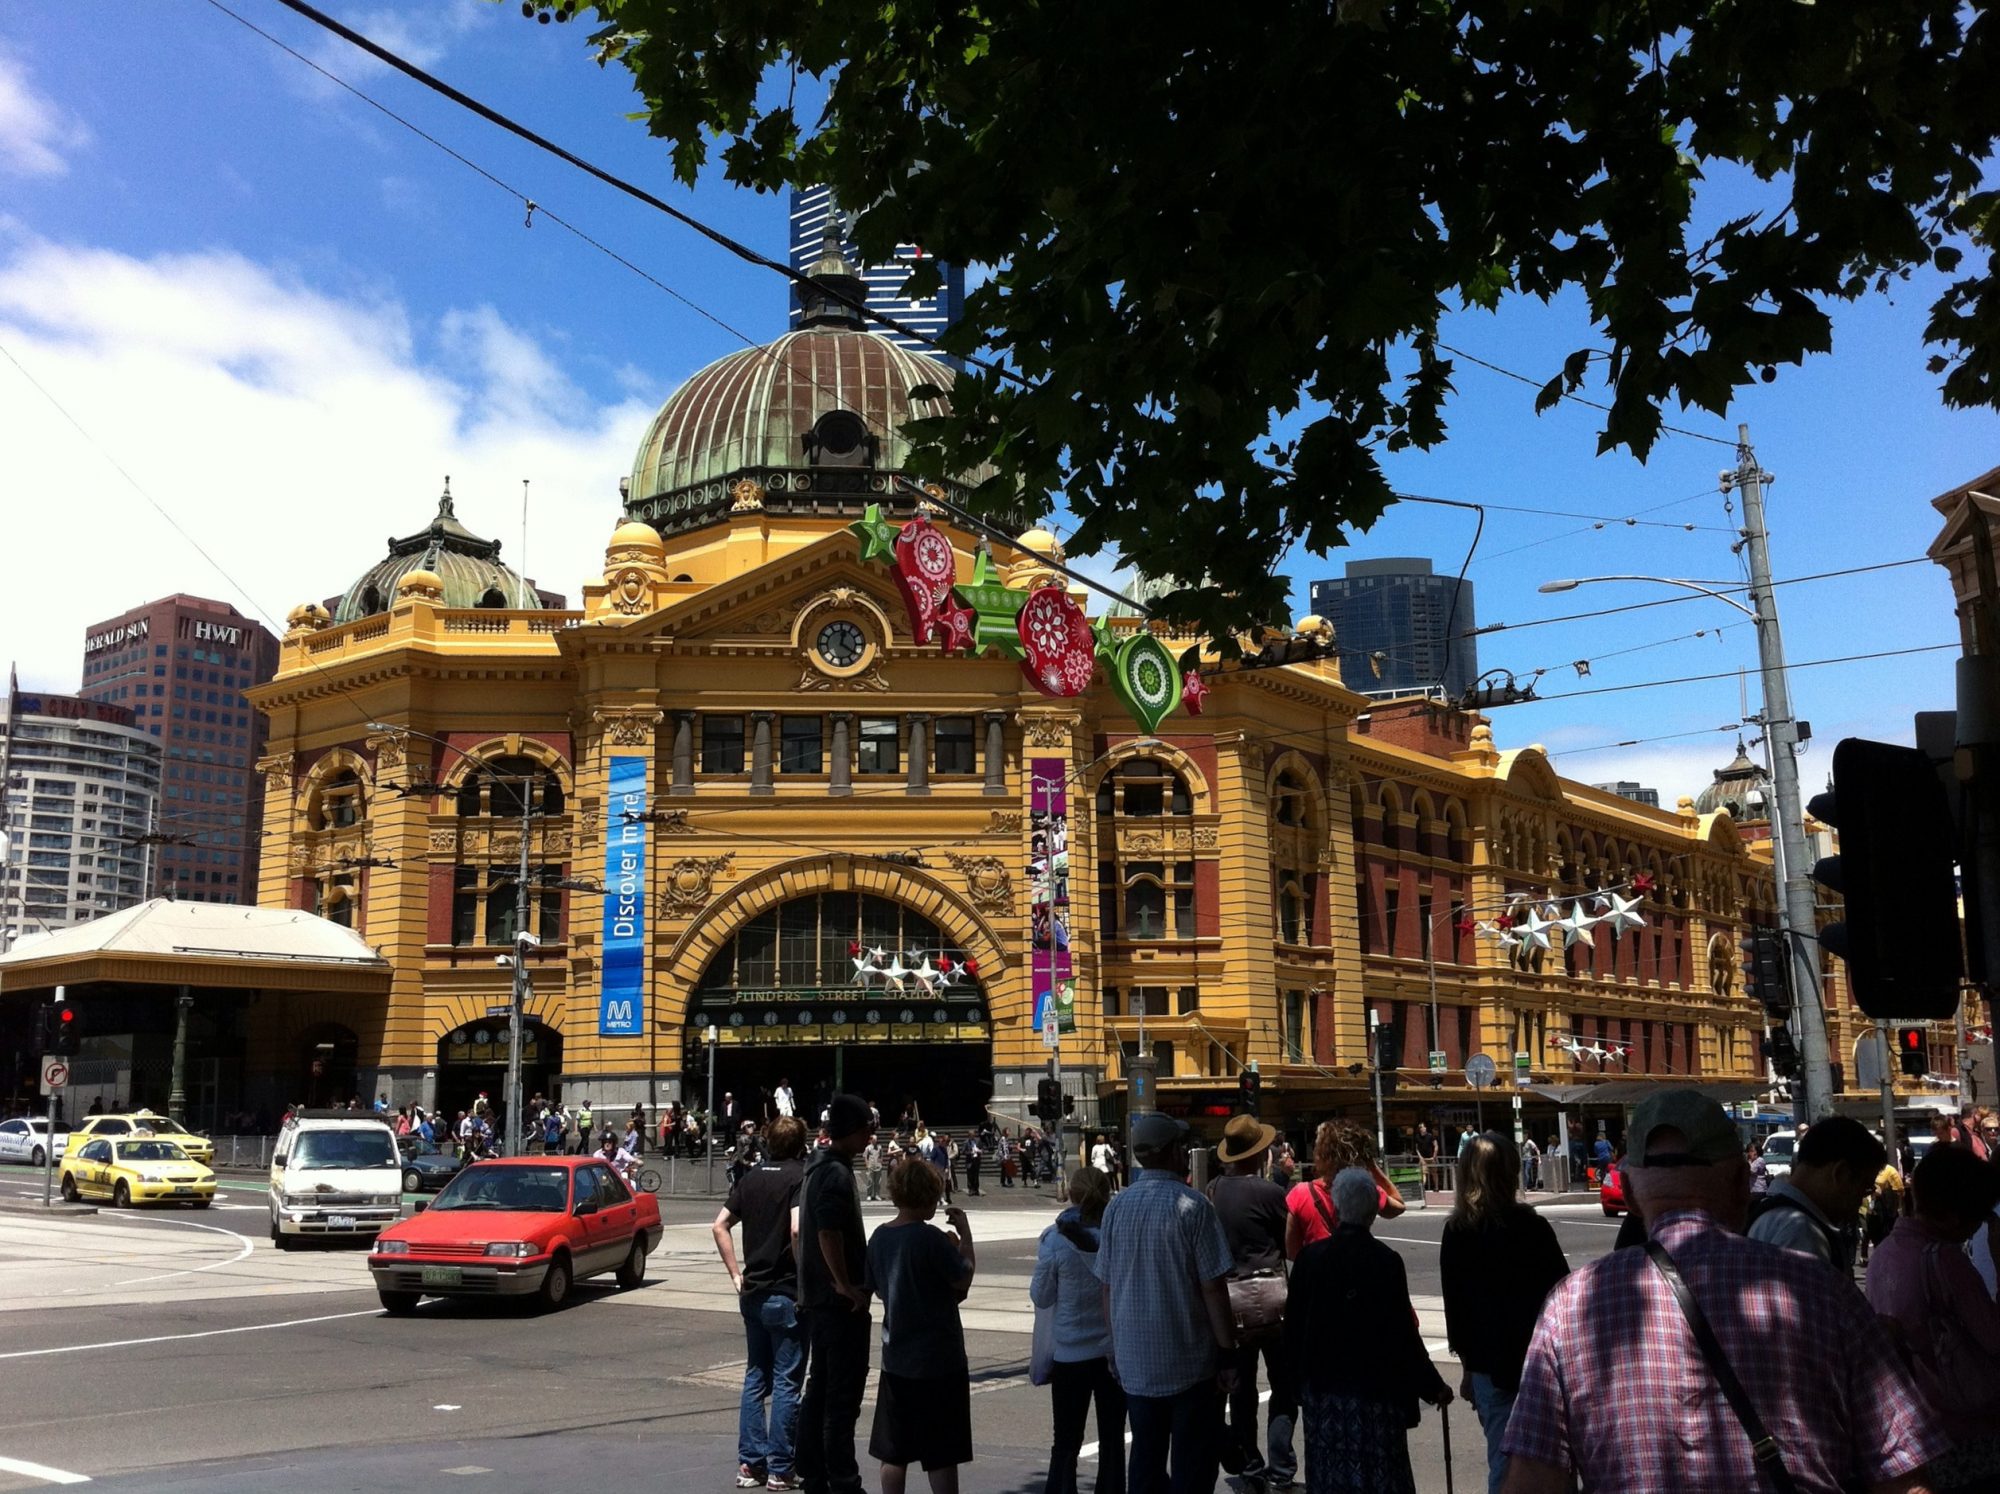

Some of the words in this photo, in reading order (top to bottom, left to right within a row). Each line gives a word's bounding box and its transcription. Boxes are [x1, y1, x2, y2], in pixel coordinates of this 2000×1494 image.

[127, 618, 149, 639] SUN
[195, 620, 240, 645] HWT
[622, 793, 639, 844] mre
[613, 849, 637, 938] Discover
[735, 990, 801, 1002] FLINDERS
[818, 990, 867, 1001] STREET
[883, 989, 944, 1001] STATION
[606, 1021, 632, 1029] METRO
